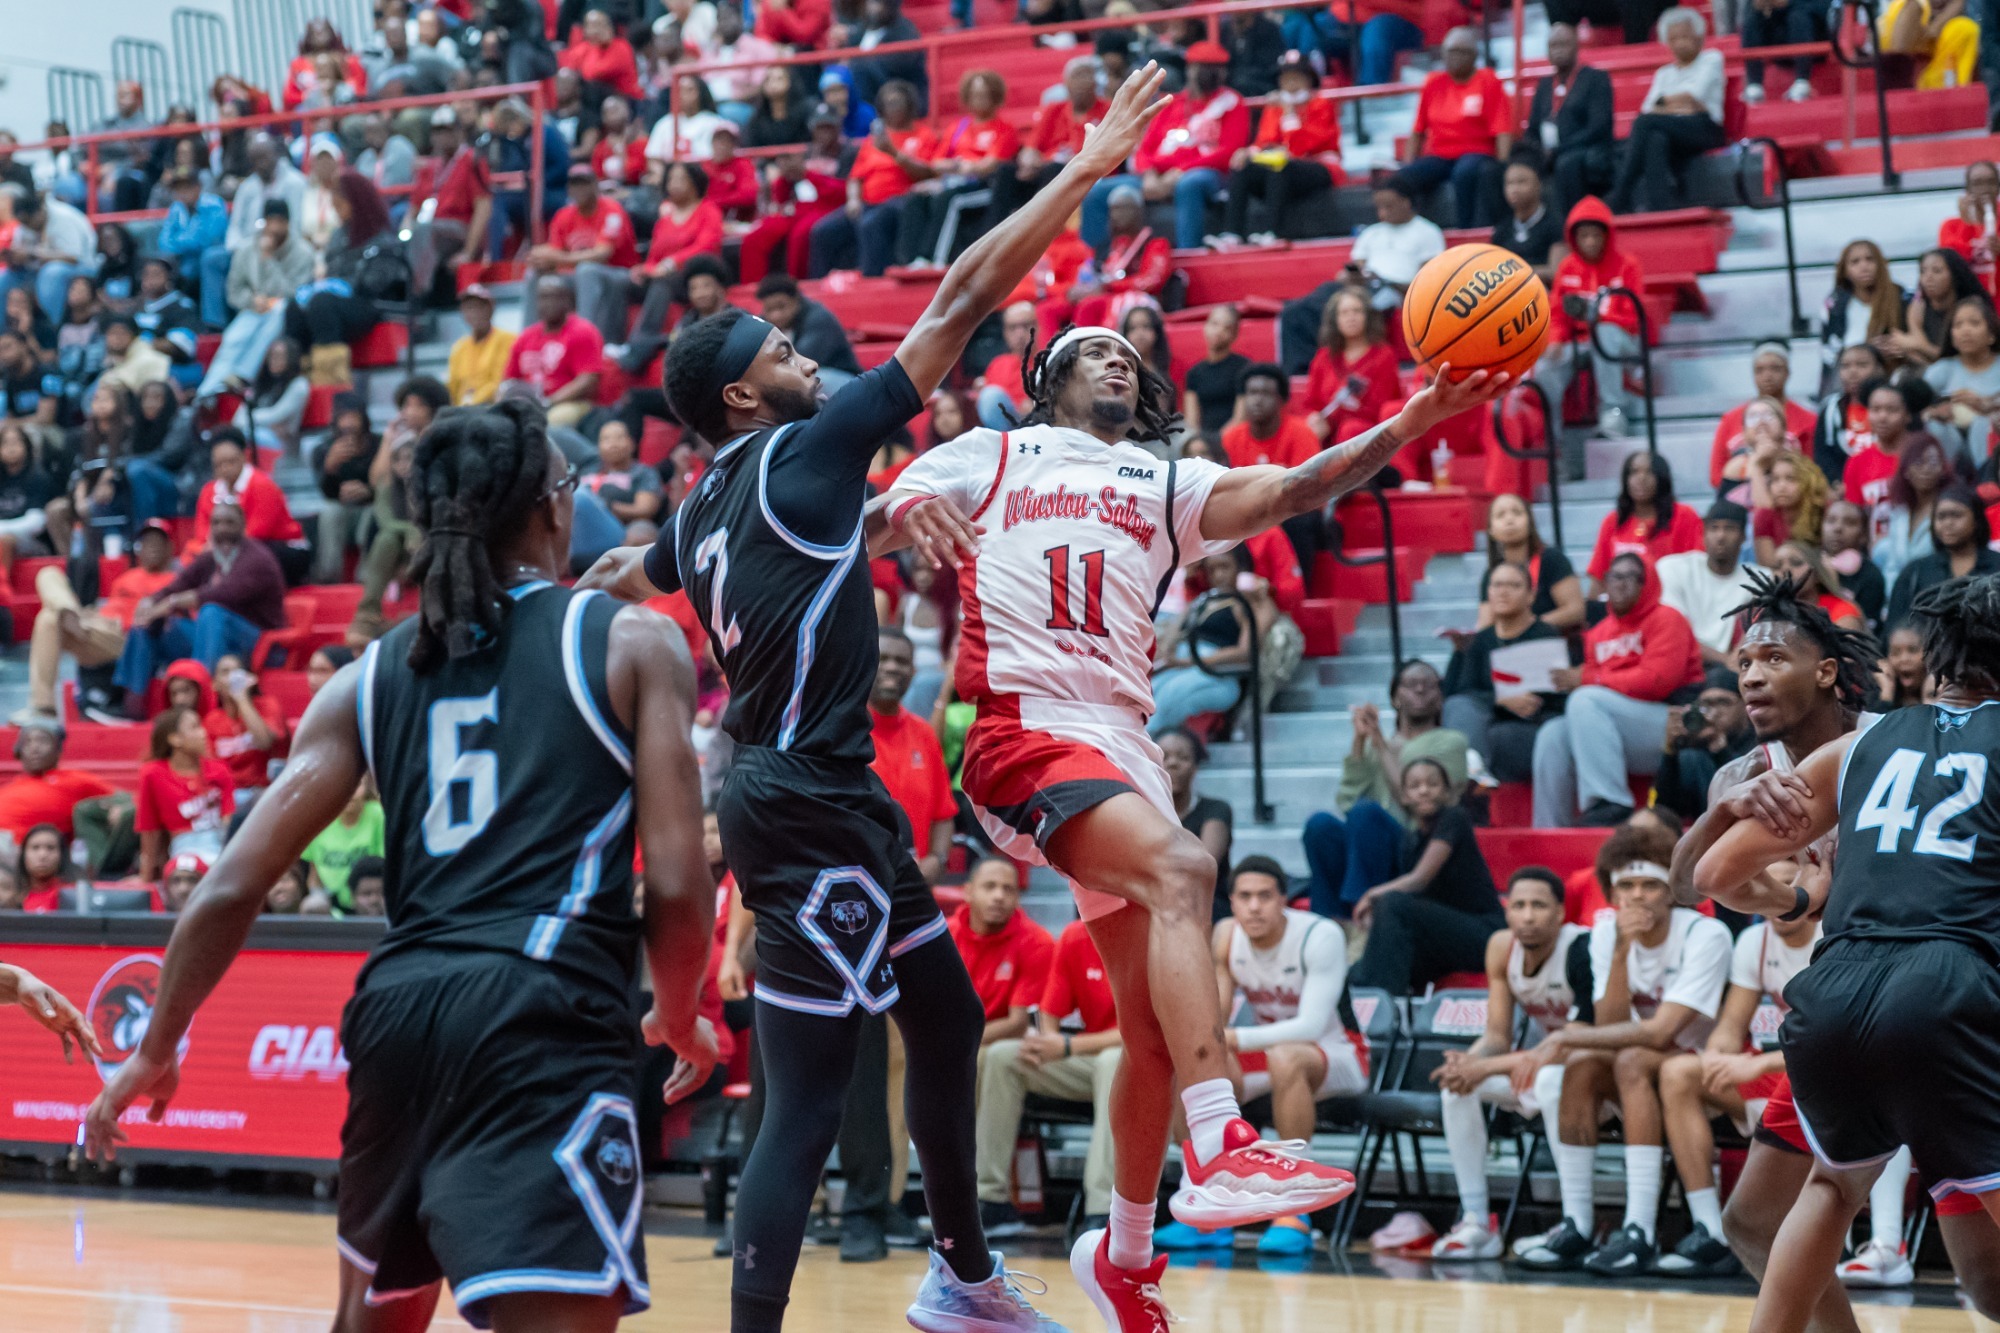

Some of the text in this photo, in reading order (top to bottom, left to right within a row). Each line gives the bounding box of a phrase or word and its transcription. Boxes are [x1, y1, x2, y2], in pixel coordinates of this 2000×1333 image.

[1445, 257, 1524, 319] Wilson
[1497, 299, 1539, 347] EVO
[1117, 466, 1155, 481] CIAA
[1003, 483, 1157, 553] Winston-Salem
[694, 526, 742, 657] 2
[1043, 543, 1110, 638] 11
[421, 685, 499, 857] 6
[1855, 747, 1989, 863] 42
[165, 1108, 248, 1130] UNIVERSITY
